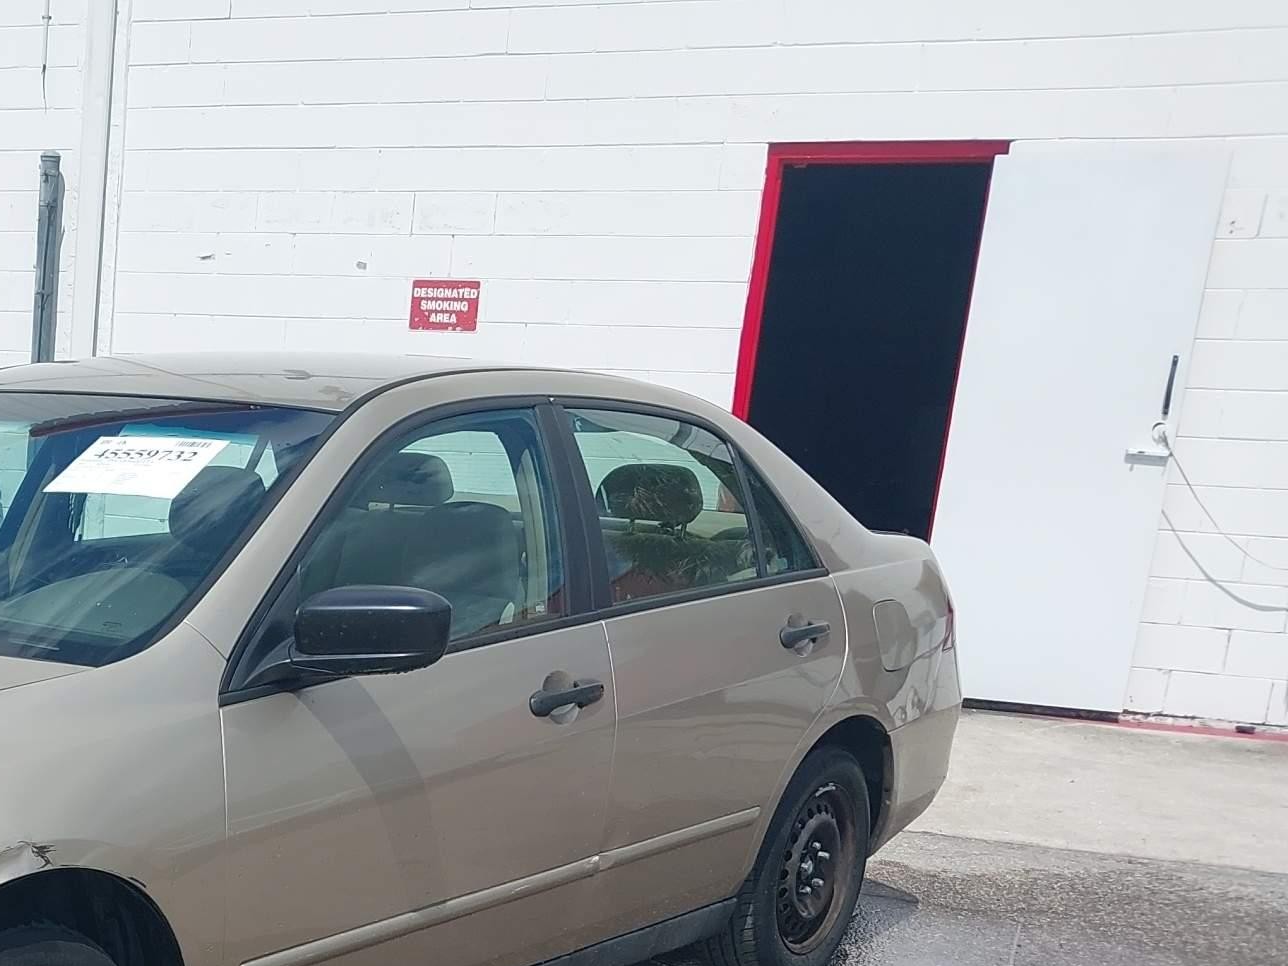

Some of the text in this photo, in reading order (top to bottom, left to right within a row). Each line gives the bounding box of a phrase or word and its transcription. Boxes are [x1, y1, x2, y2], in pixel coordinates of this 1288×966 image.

[414, 287, 478, 298] DESIGNATED
[420, 300, 469, 311] SMOKING
[429, 312, 457, 323] AREA
[94, 449, 199, 461] 45559732
